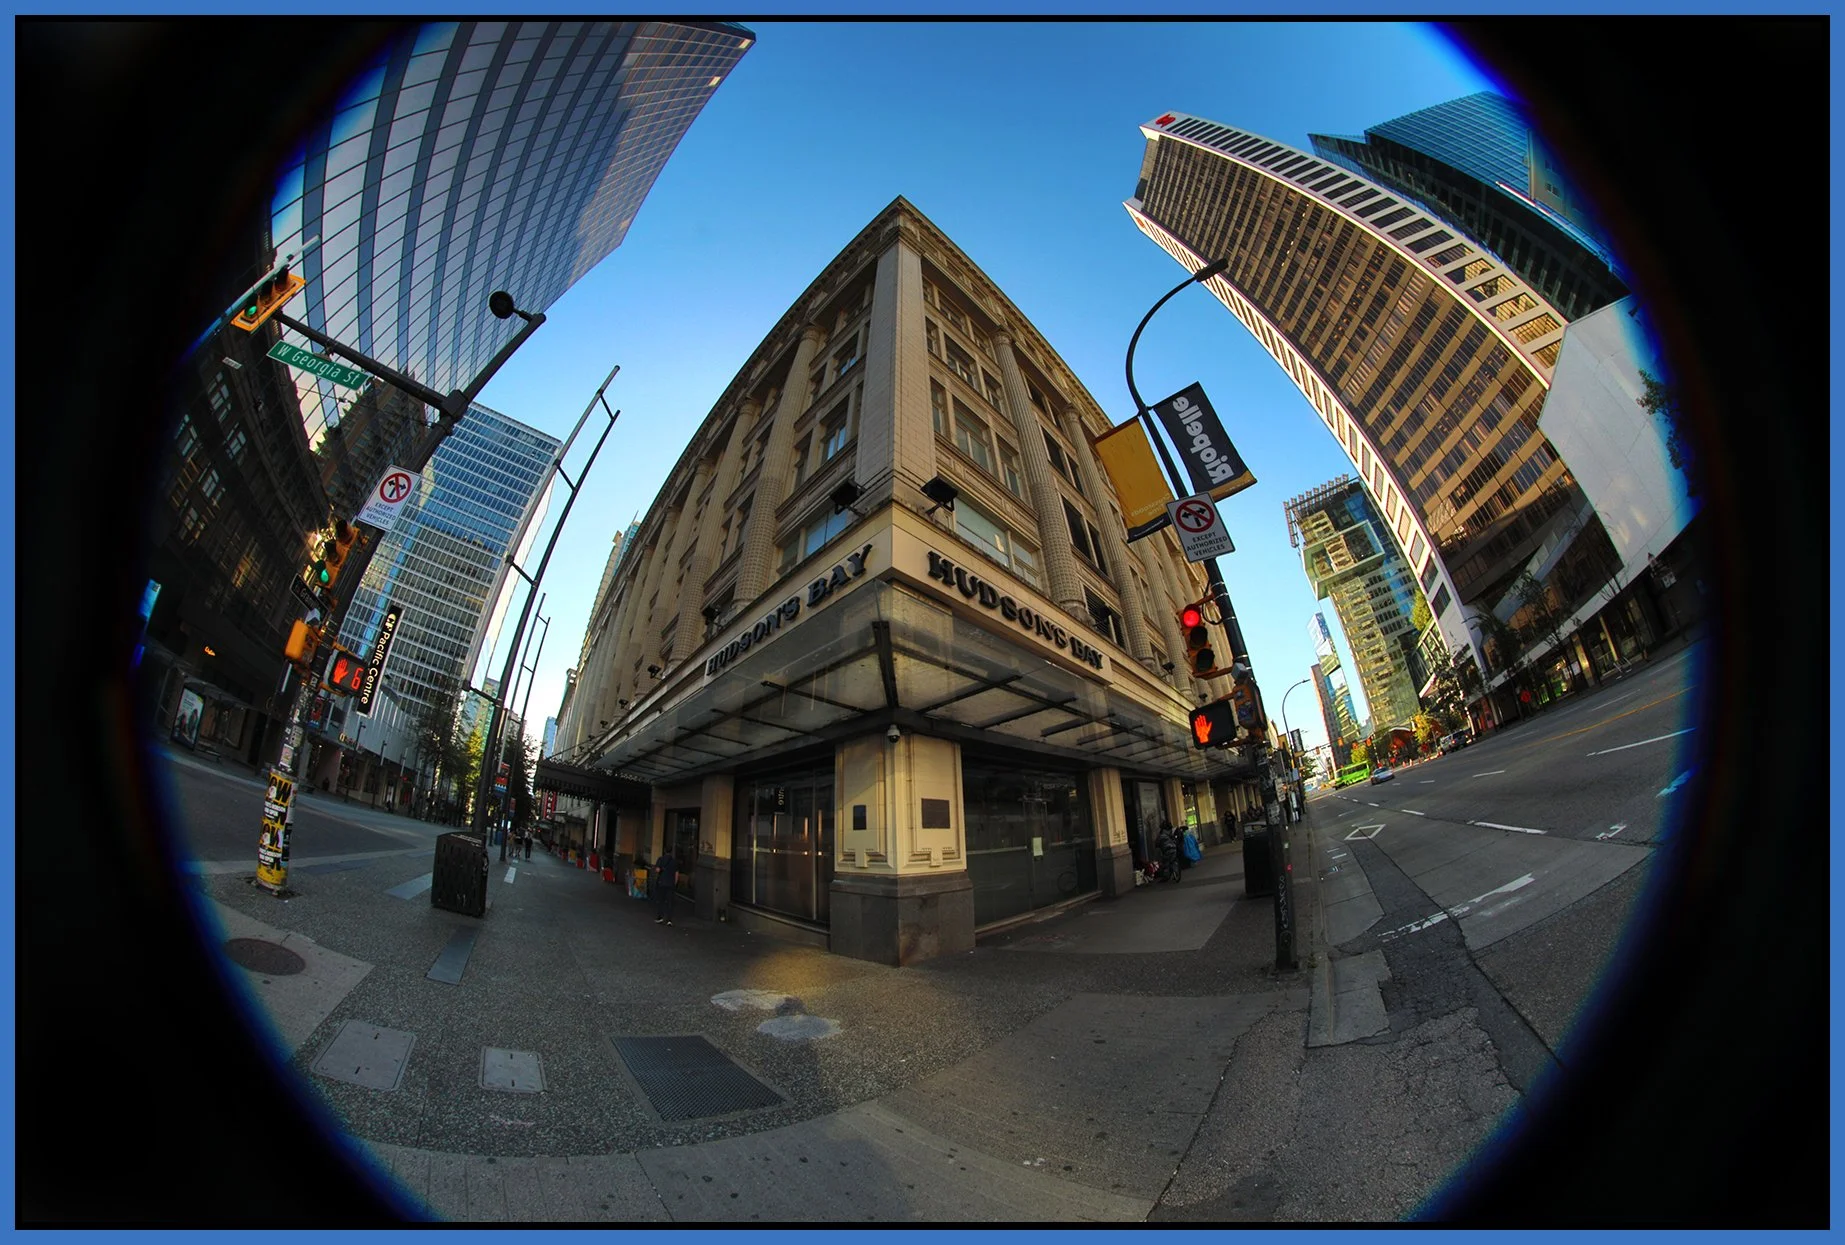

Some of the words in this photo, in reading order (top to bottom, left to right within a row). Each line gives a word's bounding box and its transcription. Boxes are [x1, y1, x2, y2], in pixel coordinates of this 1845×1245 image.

[278, 344, 292, 357] W
[292, 348, 342, 379] Georgia
[342, 371, 360, 386] St
[365, 506, 396, 521] AUTHORIZED
[375, 502, 394, 512] EXCEPT
[366, 513, 390, 526] VEHICLES
[1186, 535, 1228, 551] AUTHORIZED
[1192, 532, 1216, 543] EXCEPT
[1193, 544, 1226, 556] VEHICLES
[706, 596, 801, 677] HUDSON'S
[806, 543, 873, 607] BAY
[927, 550, 1068, 649] HUDSON'S
[1069, 636, 1103, 670] BAY
[371, 631, 392, 666] Pacific
[350, 667, 365, 690] 6
[360, 667, 379, 705] Centre
